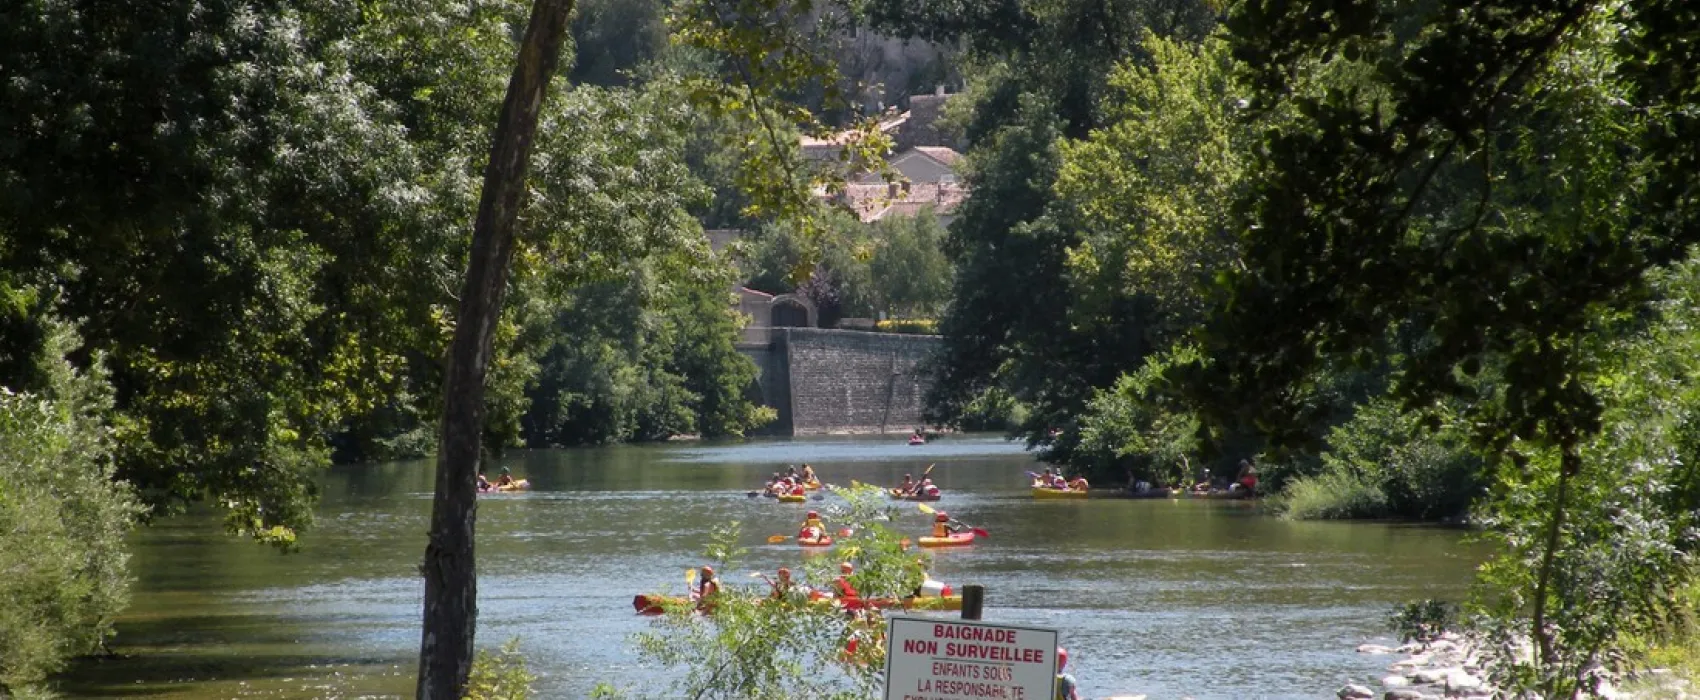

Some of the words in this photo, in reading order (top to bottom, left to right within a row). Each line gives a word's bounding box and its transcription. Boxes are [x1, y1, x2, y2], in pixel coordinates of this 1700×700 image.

[934, 624, 1016, 644] BAIGNADE
[904, 640, 938, 655] NON
[946, 642, 1044, 663] SURVEILLEE
[933, 662, 980, 679] ENFANTS
[983, 666, 1012, 682] SOUS
[917, 678, 931, 693] LA
[935, 679, 1024, 698] RESPONSABILTE
